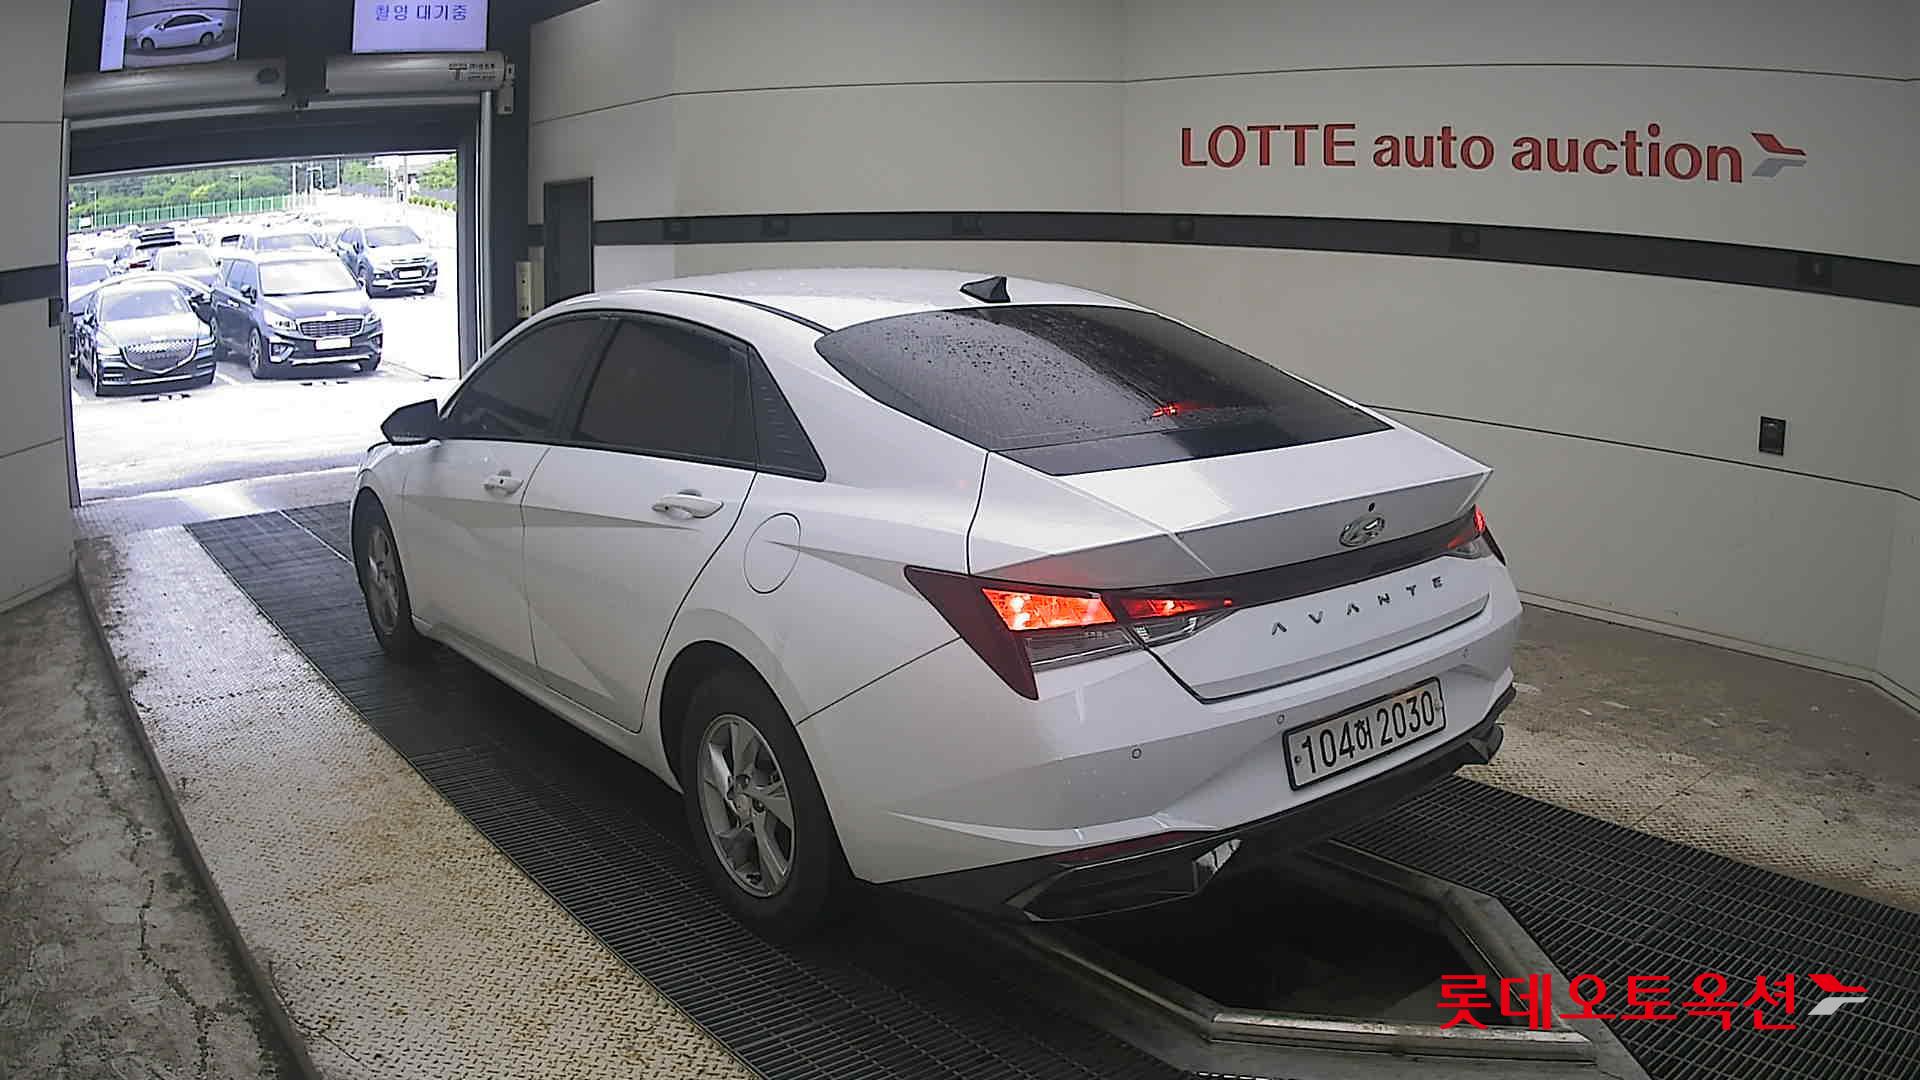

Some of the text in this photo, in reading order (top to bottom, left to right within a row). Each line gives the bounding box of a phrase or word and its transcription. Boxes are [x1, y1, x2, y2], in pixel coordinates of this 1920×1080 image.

[416, 4, 467, 21] 대기중
[1182, 123, 1743, 183] LOTTE auto auction
[1271, 576, 1444, 636] AVANTE
